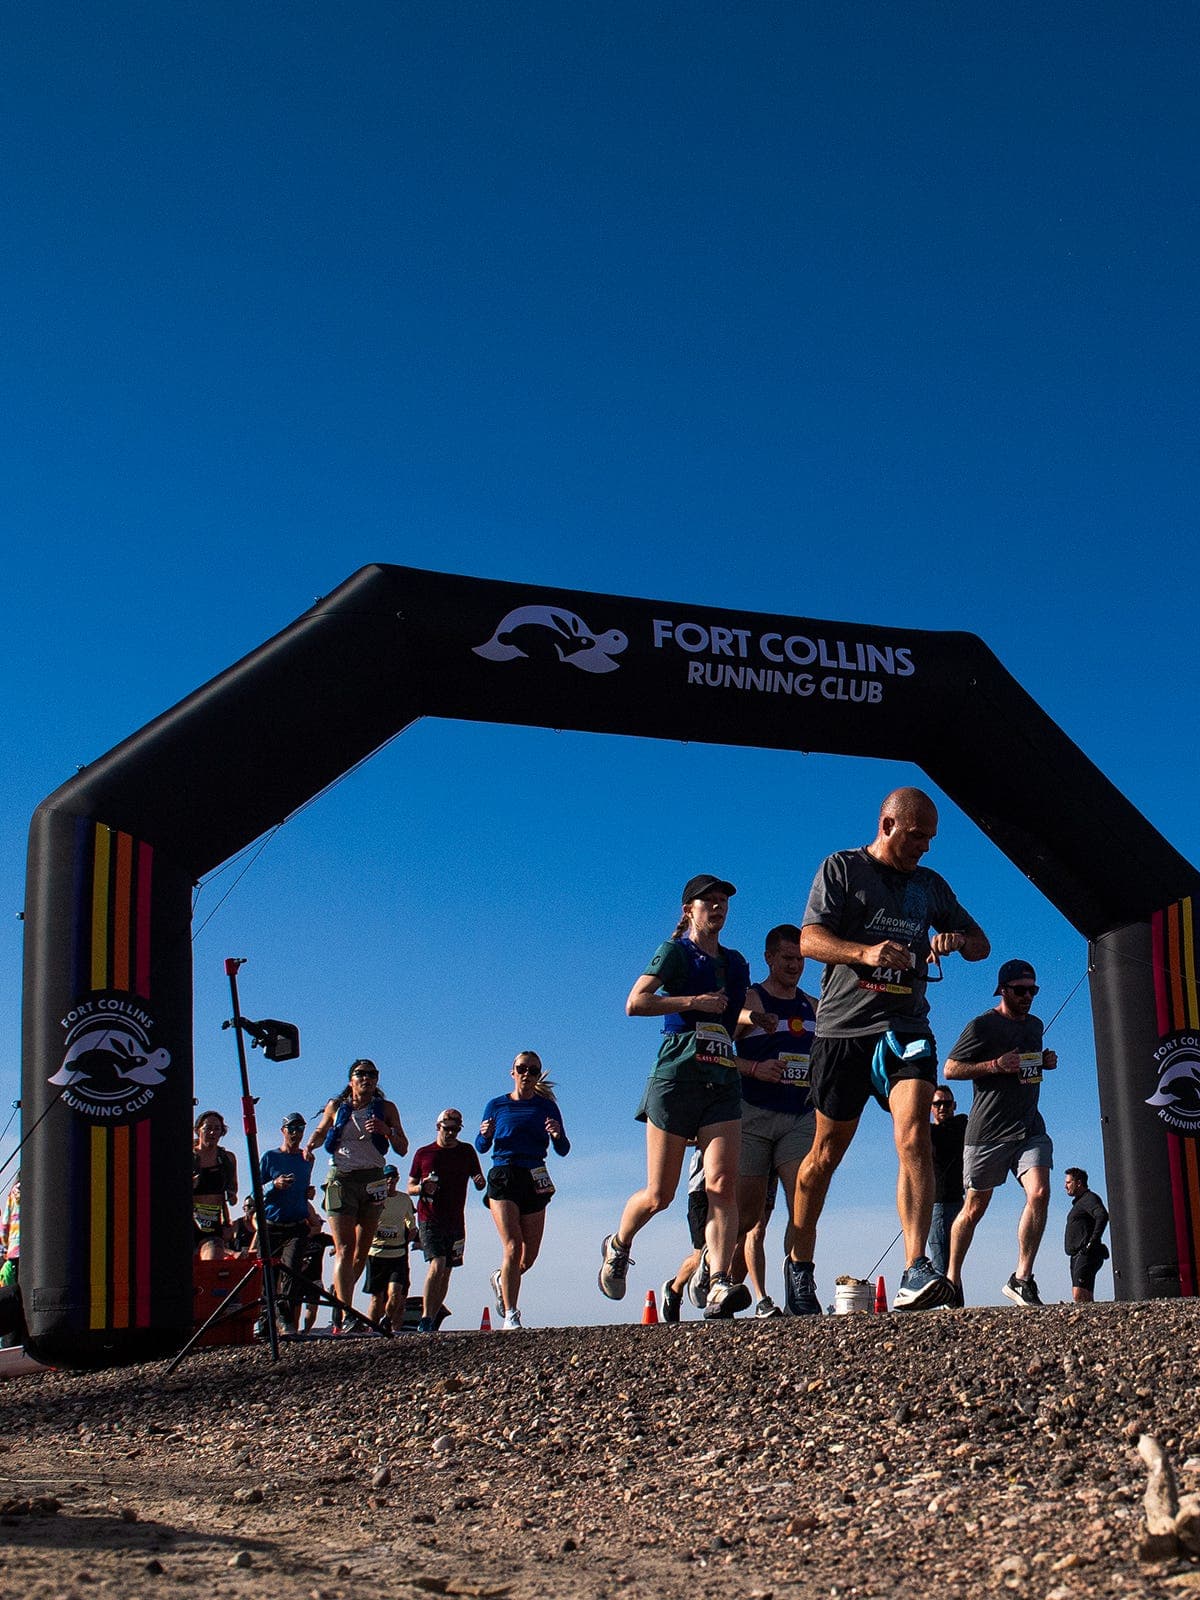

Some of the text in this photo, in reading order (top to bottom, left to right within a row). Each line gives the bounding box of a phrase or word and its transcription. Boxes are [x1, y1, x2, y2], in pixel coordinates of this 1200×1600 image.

[653, 619, 916, 676] FORT COLLINS
[687, 660, 883, 703] RUNNING CLUB
[864, 908, 922, 932] ARROWHEA
[872, 967, 902, 984] 441
[60, 999, 154, 1029] FORT COLLINS
[706, 1041, 728, 1057] 411
[1153, 1040, 1178, 1060] FORT
[782, 1068, 808, 1080] 1837
[1021, 1067, 1039, 1078] 724
[60, 1088, 154, 1116] RUNNING CLUB
